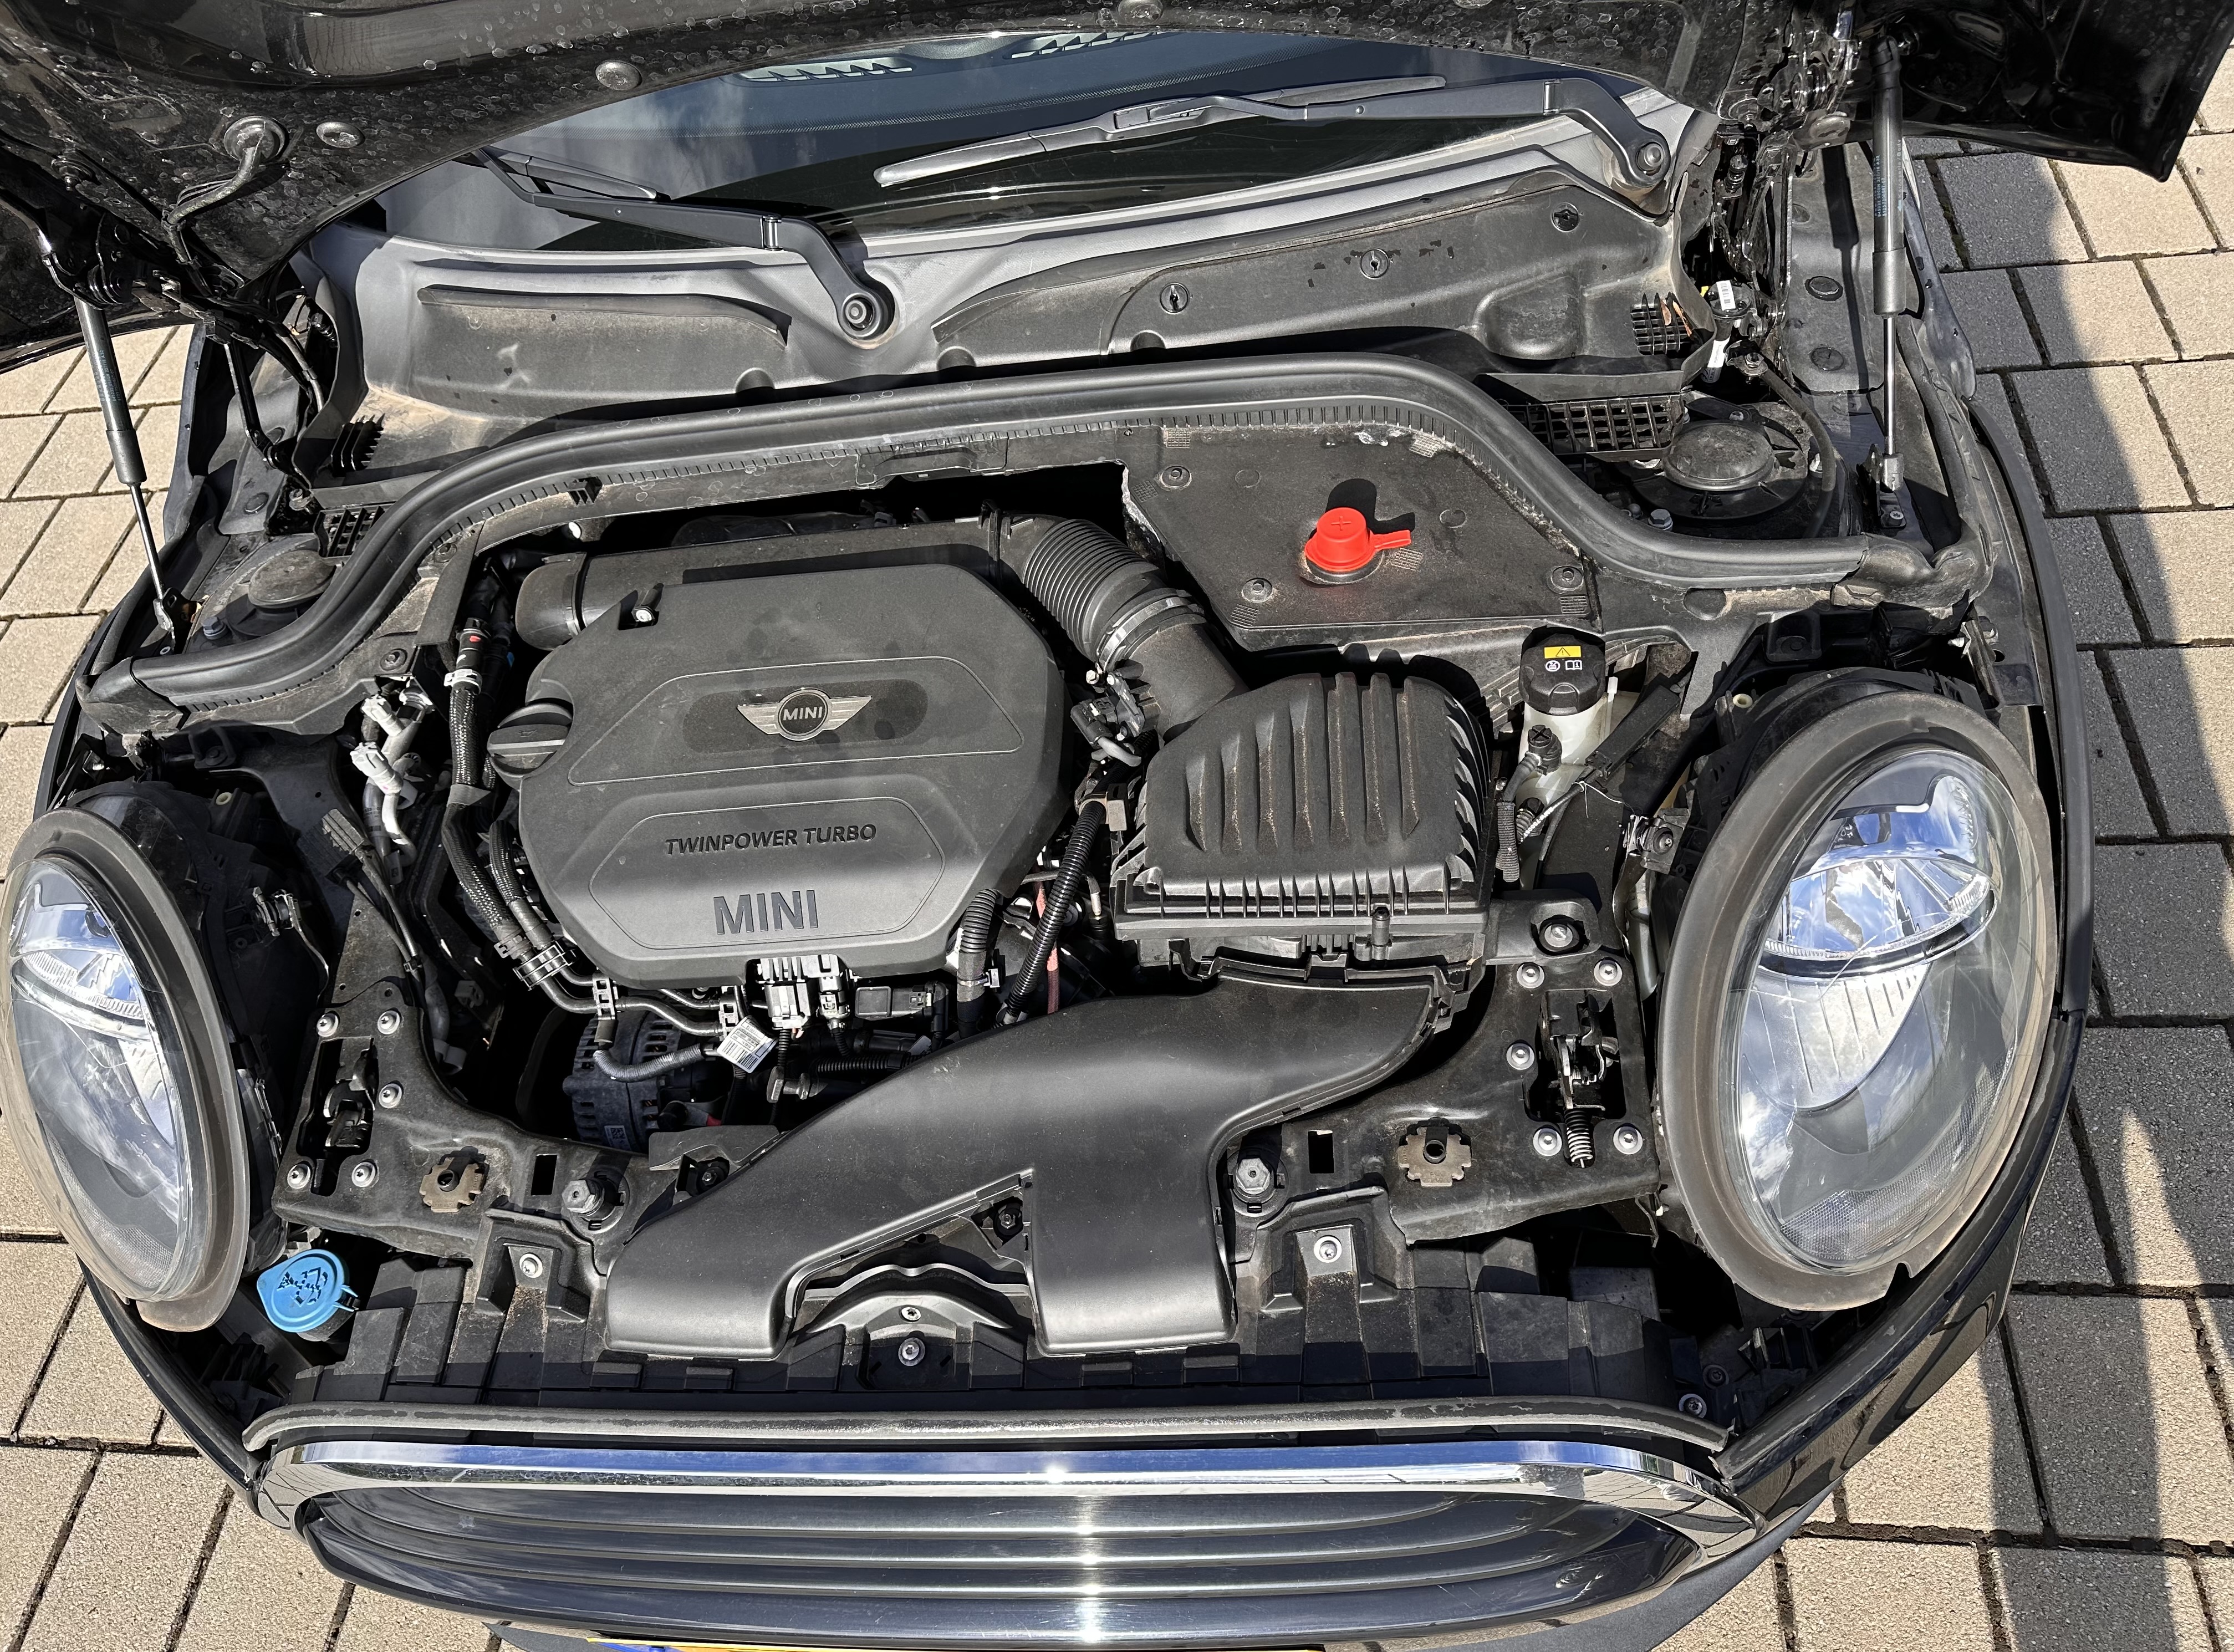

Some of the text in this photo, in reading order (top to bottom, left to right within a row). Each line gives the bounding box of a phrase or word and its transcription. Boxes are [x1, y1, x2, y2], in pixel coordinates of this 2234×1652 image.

[783, 706, 823, 720] MINI
[665, 824, 876, 854] TWINPOWER TURBO
[713, 890, 818, 935] MINI
